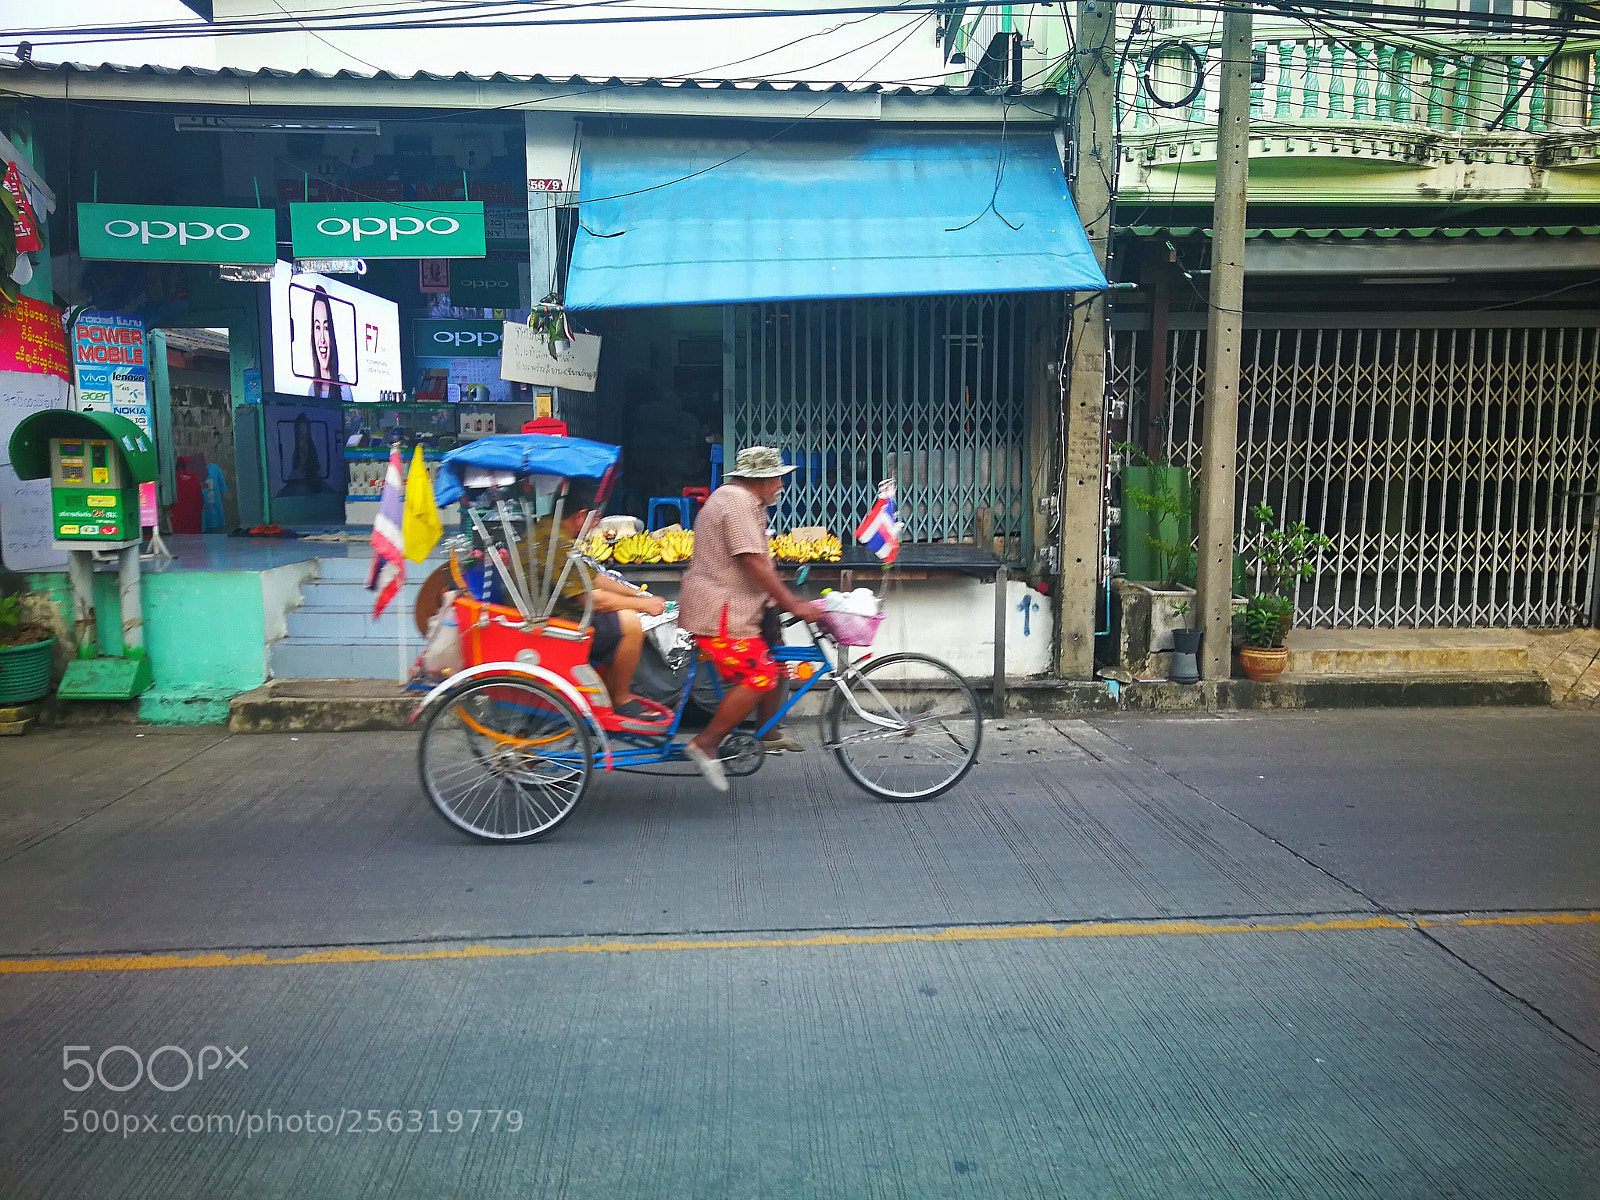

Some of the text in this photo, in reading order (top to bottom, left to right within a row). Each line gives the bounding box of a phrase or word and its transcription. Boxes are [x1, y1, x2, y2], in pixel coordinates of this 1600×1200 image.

[278, 181, 527, 202] POWER MOBIL
[530, 180, 560, 190] 56/9
[76, 325, 143, 346] POWER
[365, 323, 378, 353] F7
[433, 331, 504, 347] opp
[77, 345, 144, 365] MOBILE
[81, 373, 107, 382] vivo
[112, 372, 145, 382] lenovo
[81, 391, 109, 401] acer
[113, 407, 146, 415] NOKIA
